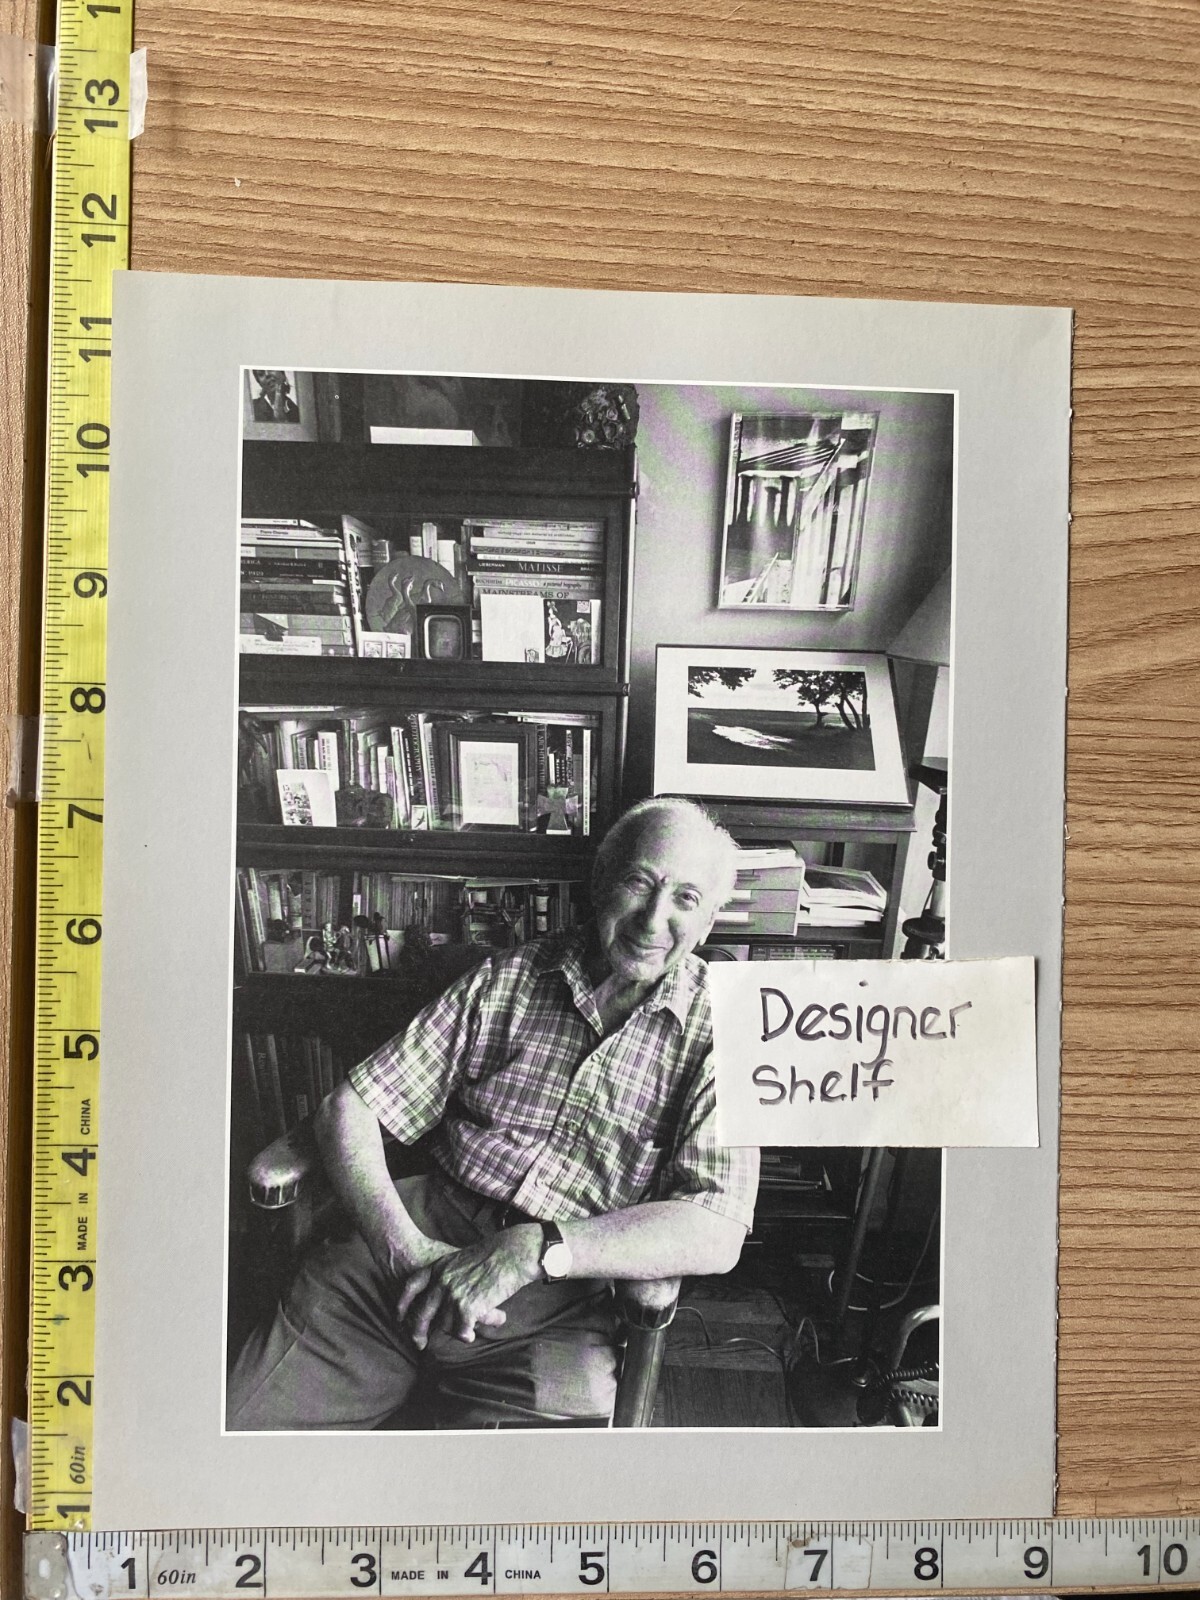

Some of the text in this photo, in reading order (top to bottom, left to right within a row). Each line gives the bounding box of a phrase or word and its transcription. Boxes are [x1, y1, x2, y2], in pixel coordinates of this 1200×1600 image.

[84, 79, 120, 134] 13
[81, 193, 117, 249] 12
[78, 316, 112, 363] 11
[76, 422, 110, 478] 10
[73, 571, 107, 598] 9
[505, 578, 541, 588] PICASSO
[518, 562, 565, 573] MATISSE
[70, 687, 106, 714] 8
[67, 803, 103, 829] 7
[65, 918, 102, 945] 6
[760, 981, 973, 1070] Designer
[63, 1034, 99, 1061] 5
[752, 1058, 895, 1106] Shelf
[61, 1148, 96, 1176] 4
[77, 1098, 92, 1251] MADE IN CHINA
[58, 1264, 94, 1292] 3
[56, 1380, 92, 1406] 2
[69, 1446, 86, 1485] 60in
[56, 1504, 90, 1519] 1
[120, 1557, 136, 1590] 1
[157, 1568, 197, 1586] 60in
[235, 1554, 264, 1588] 2
[350, 1552, 378, 1588] 3
[391, 1569, 542, 1581] MADE IN CHINA
[463, 1551, 493, 1586] 4
[578, 1551, 606, 1586] 5
[691, 1549, 718, 1584] 6
[803, 1549, 828, 1582] 7
[913, 1547, 939, 1581] 8
[1023, 1546, 1049, 1580] 9
[1136, 1543, 1189, 1577] 10
